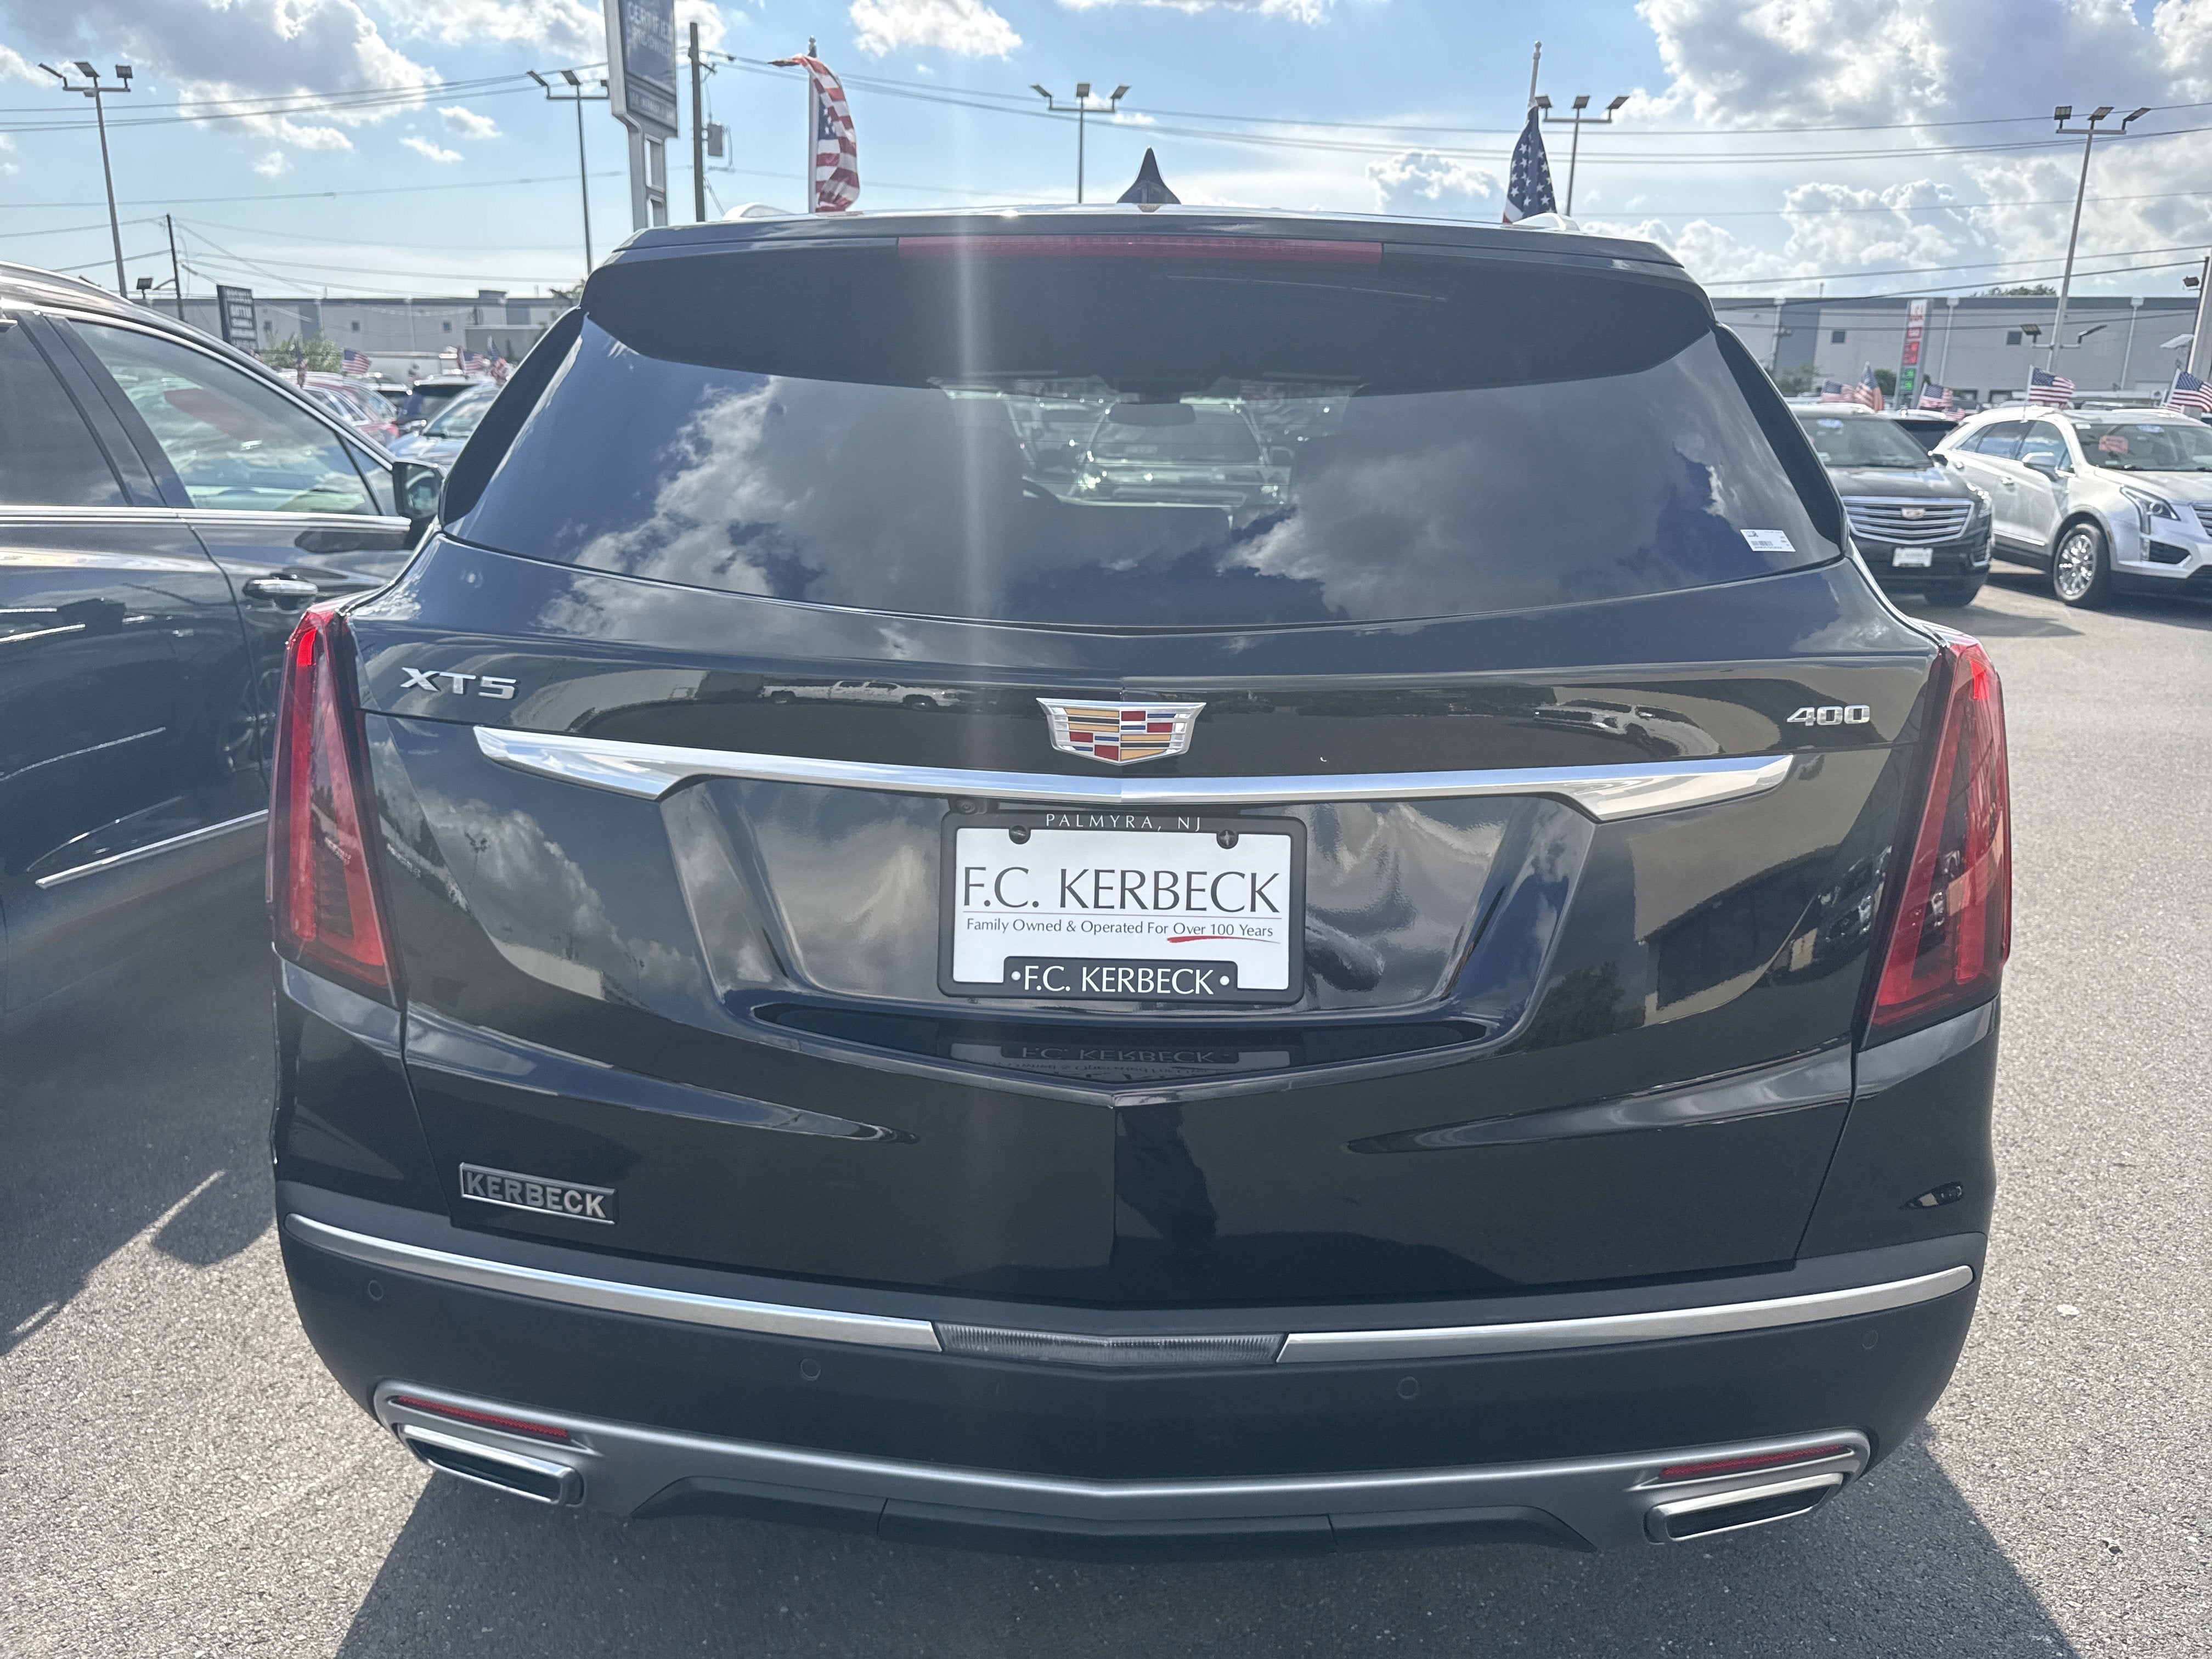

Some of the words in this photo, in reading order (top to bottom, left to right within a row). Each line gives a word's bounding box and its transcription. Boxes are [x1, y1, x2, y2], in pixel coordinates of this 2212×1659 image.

[400, 667, 517, 699] XT5
[1787, 705, 1870, 726] 400
[1046, 814, 1161, 831] PALMYRA,
[1178, 816, 1200, 832] NJ
[963, 866, 1039, 908] F.C.
[1059, 868, 1280, 913] KERBECK
[967, 918, 1009, 933] Family
[1013, 919, 1062, 931] Owned
[1066, 921, 1076, 932] &
[1081, 919, 1143, 935] Operated
[1147, 922, 1169, 934] For
[1173, 922, 1206, 935] Over
[1210, 924, 1234, 935] 100
[1239, 924, 1273, 936] Years
[1024, 966, 1070, 991] F.C.
[1082, 967, 1214, 995] KERBECK
[466, 1171, 606, 1218] KERBECK
